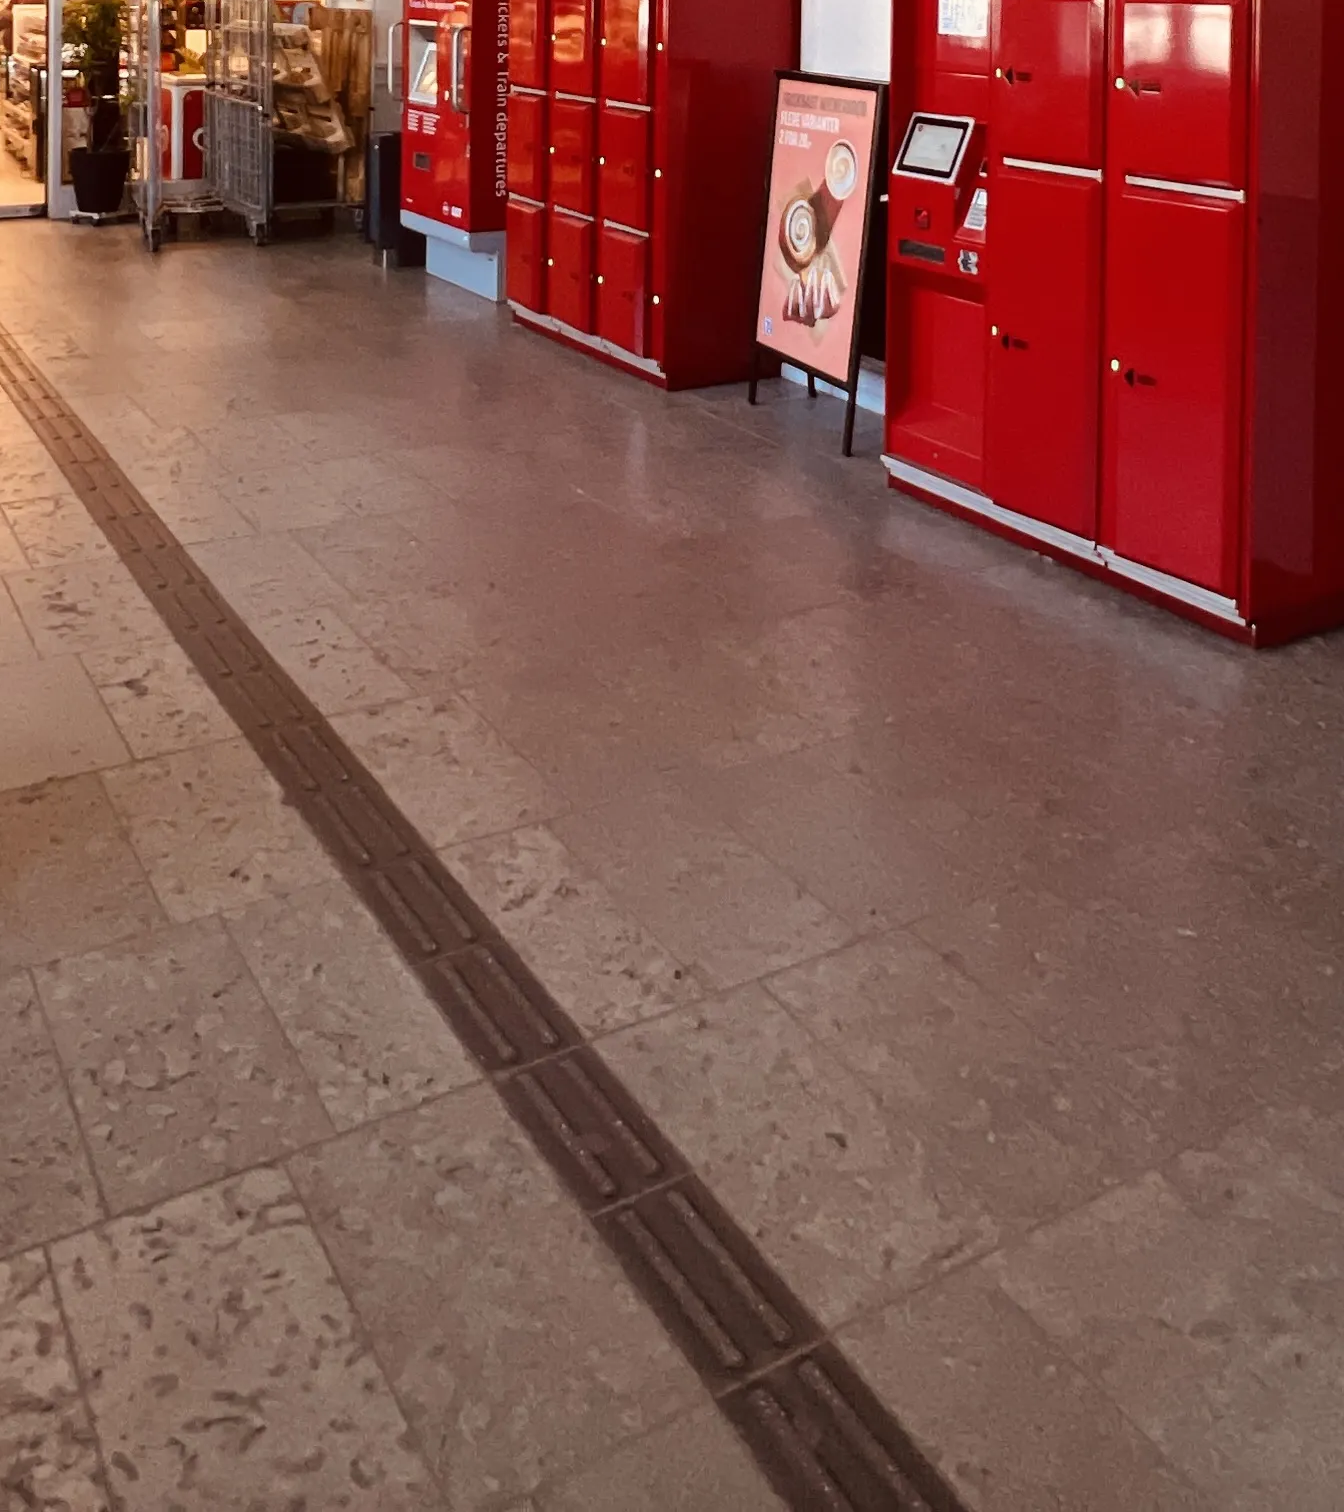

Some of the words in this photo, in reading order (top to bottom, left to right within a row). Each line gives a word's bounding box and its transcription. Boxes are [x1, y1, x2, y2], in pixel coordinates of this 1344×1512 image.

[497, 52, 510, 64] &
[496, 71, 510, 107] Train
[494, 112, 509, 198] departures
